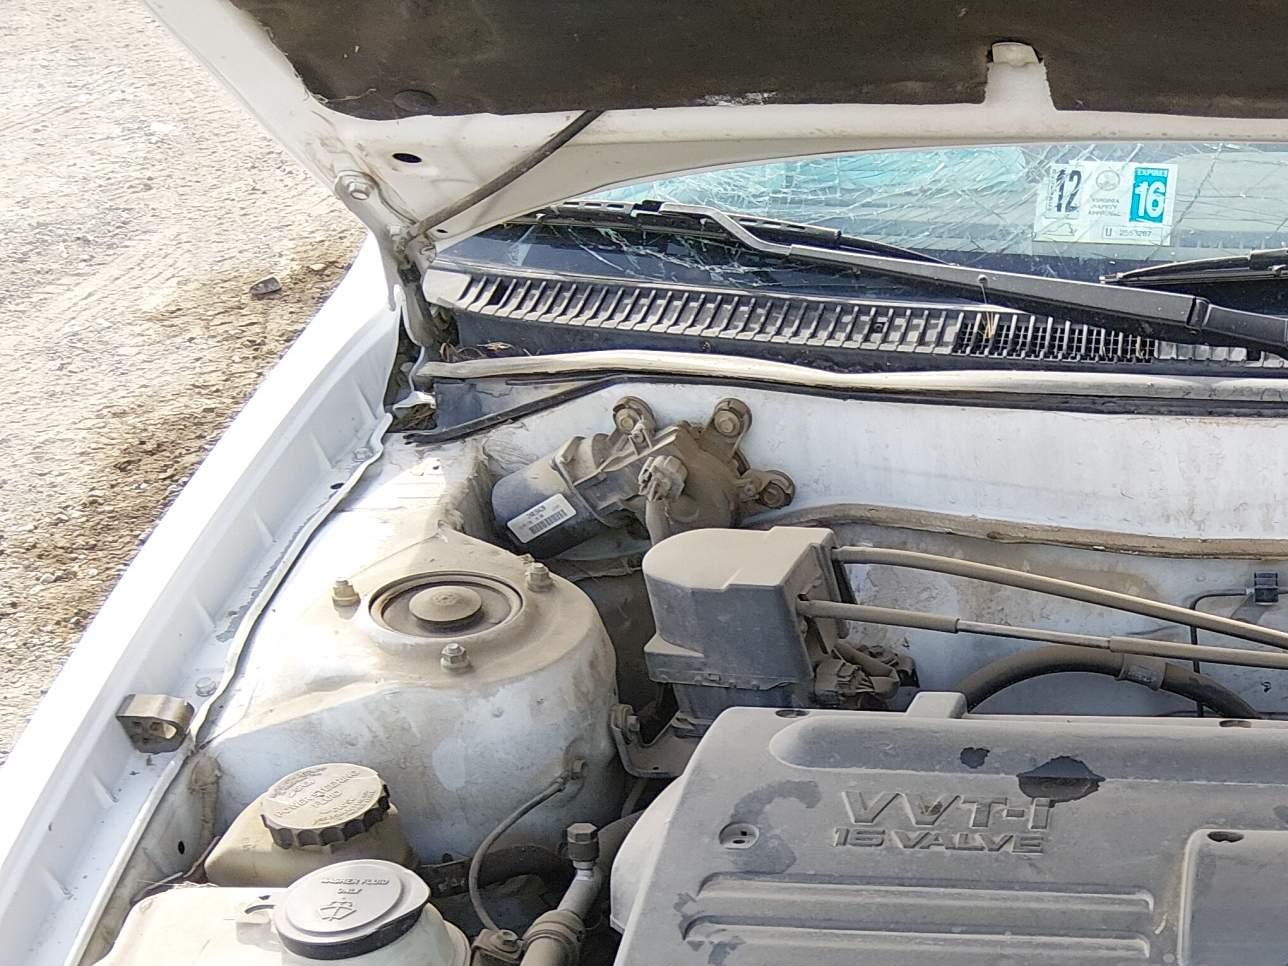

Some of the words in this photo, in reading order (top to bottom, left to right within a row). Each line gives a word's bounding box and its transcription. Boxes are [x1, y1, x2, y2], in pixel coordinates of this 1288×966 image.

[1056, 169, 1082, 213] 12
[1135, 181, 1166, 217] 16
[891, 830, 1044, 854] VALVE
